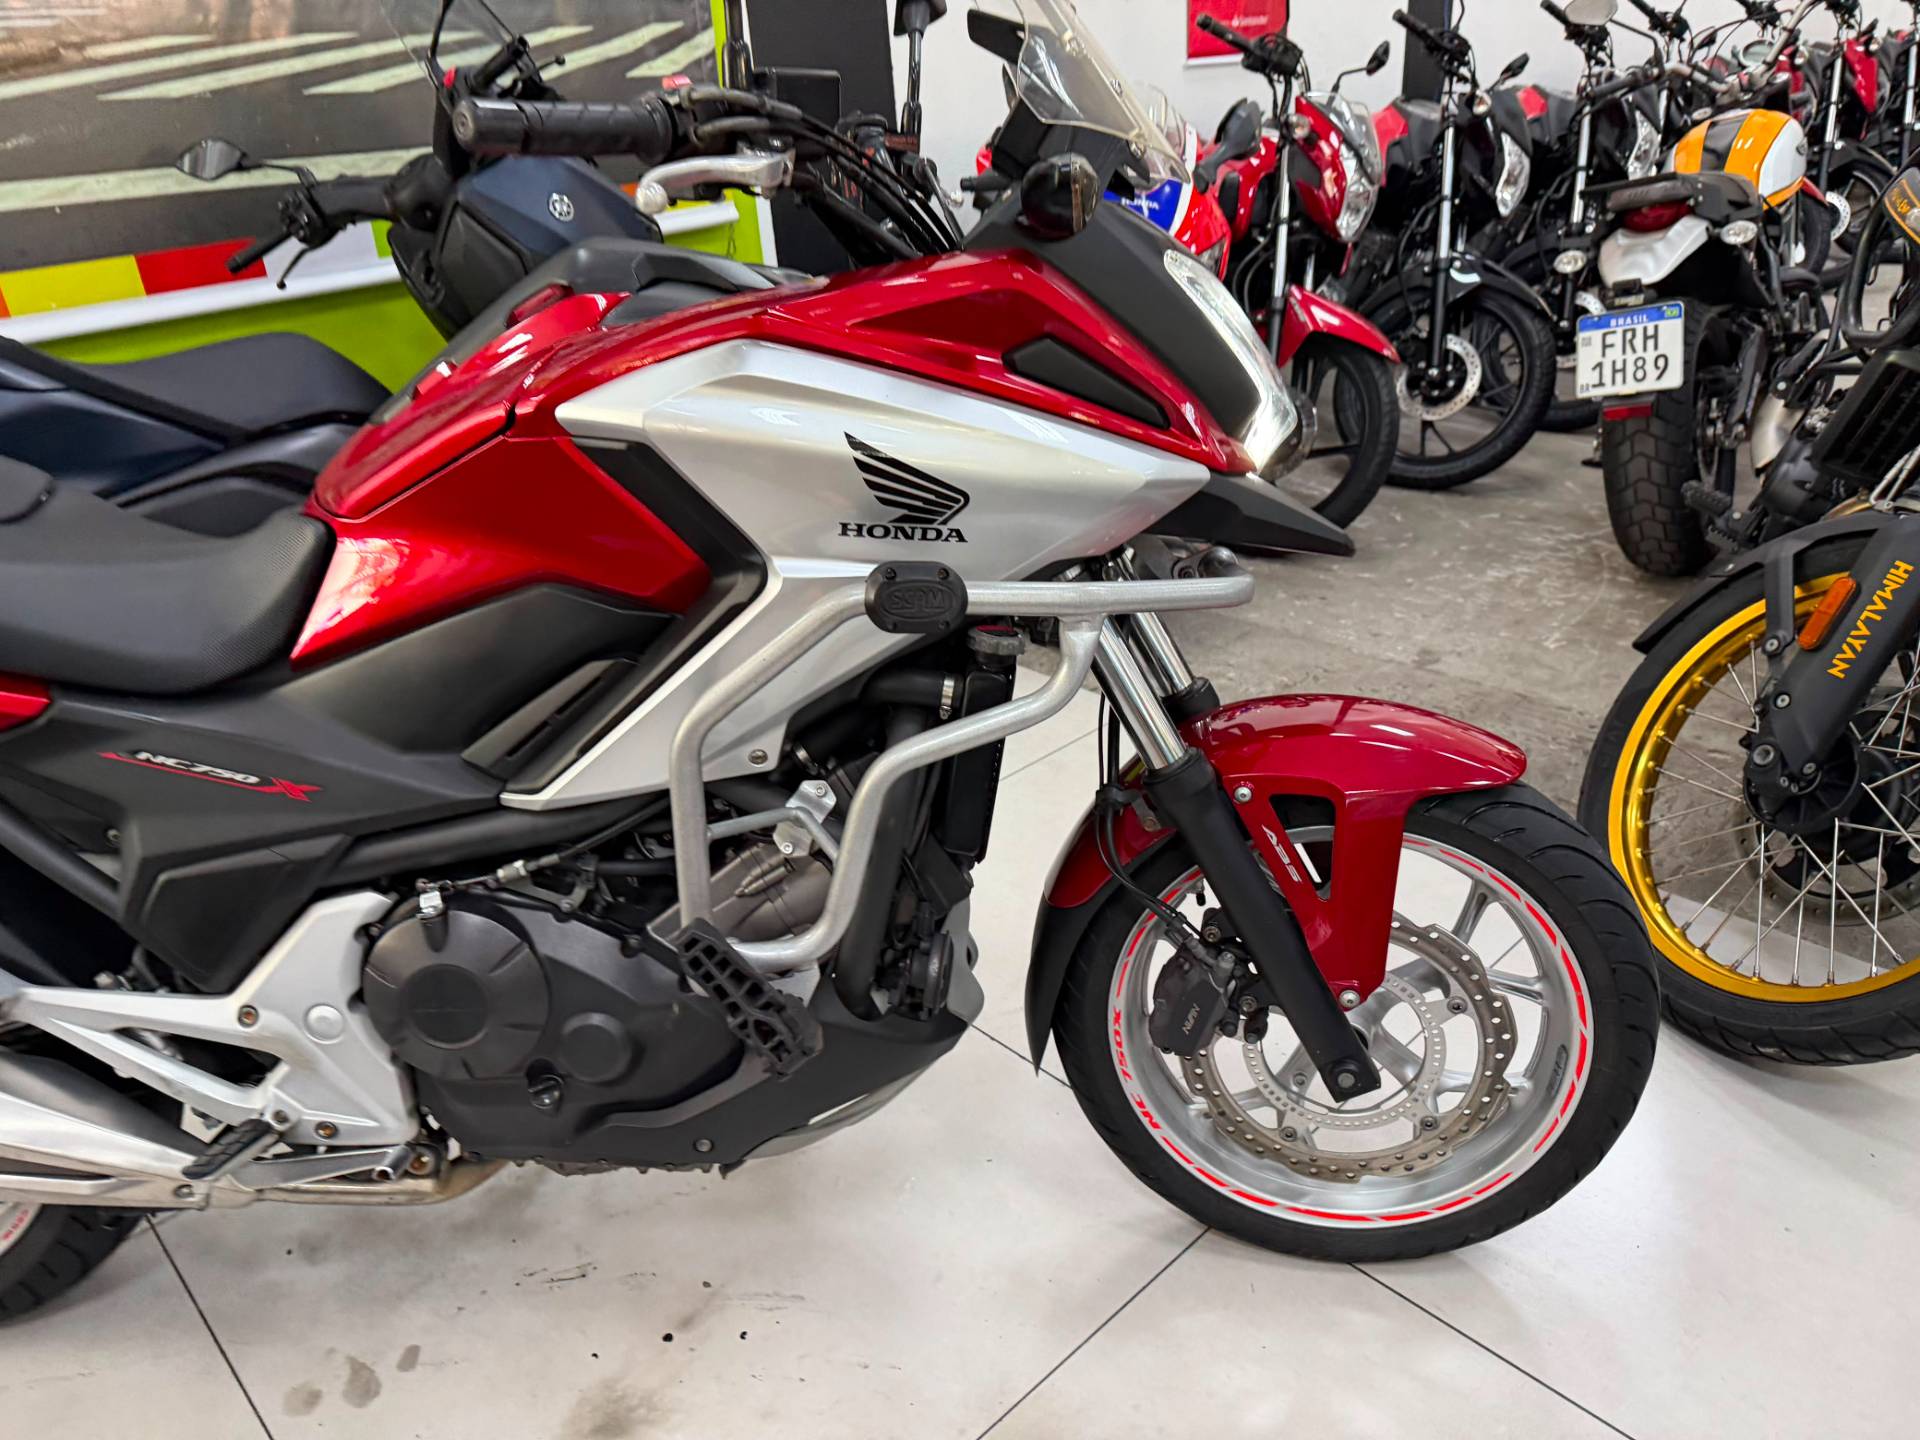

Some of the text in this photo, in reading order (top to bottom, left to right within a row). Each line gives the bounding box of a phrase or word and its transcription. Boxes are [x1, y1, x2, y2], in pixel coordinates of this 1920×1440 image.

[1609, 313, 1648, 328] BRASIL
[1601, 324, 1659, 358] FRH
[1591, 353, 1669, 388] 1H89
[838, 522, 969, 543] HONDA
[1826, 560, 1915, 679] HIMALAYAN
[1261, 824, 1303, 884] ABS
[1112, 1005, 1133, 1083] 750X
